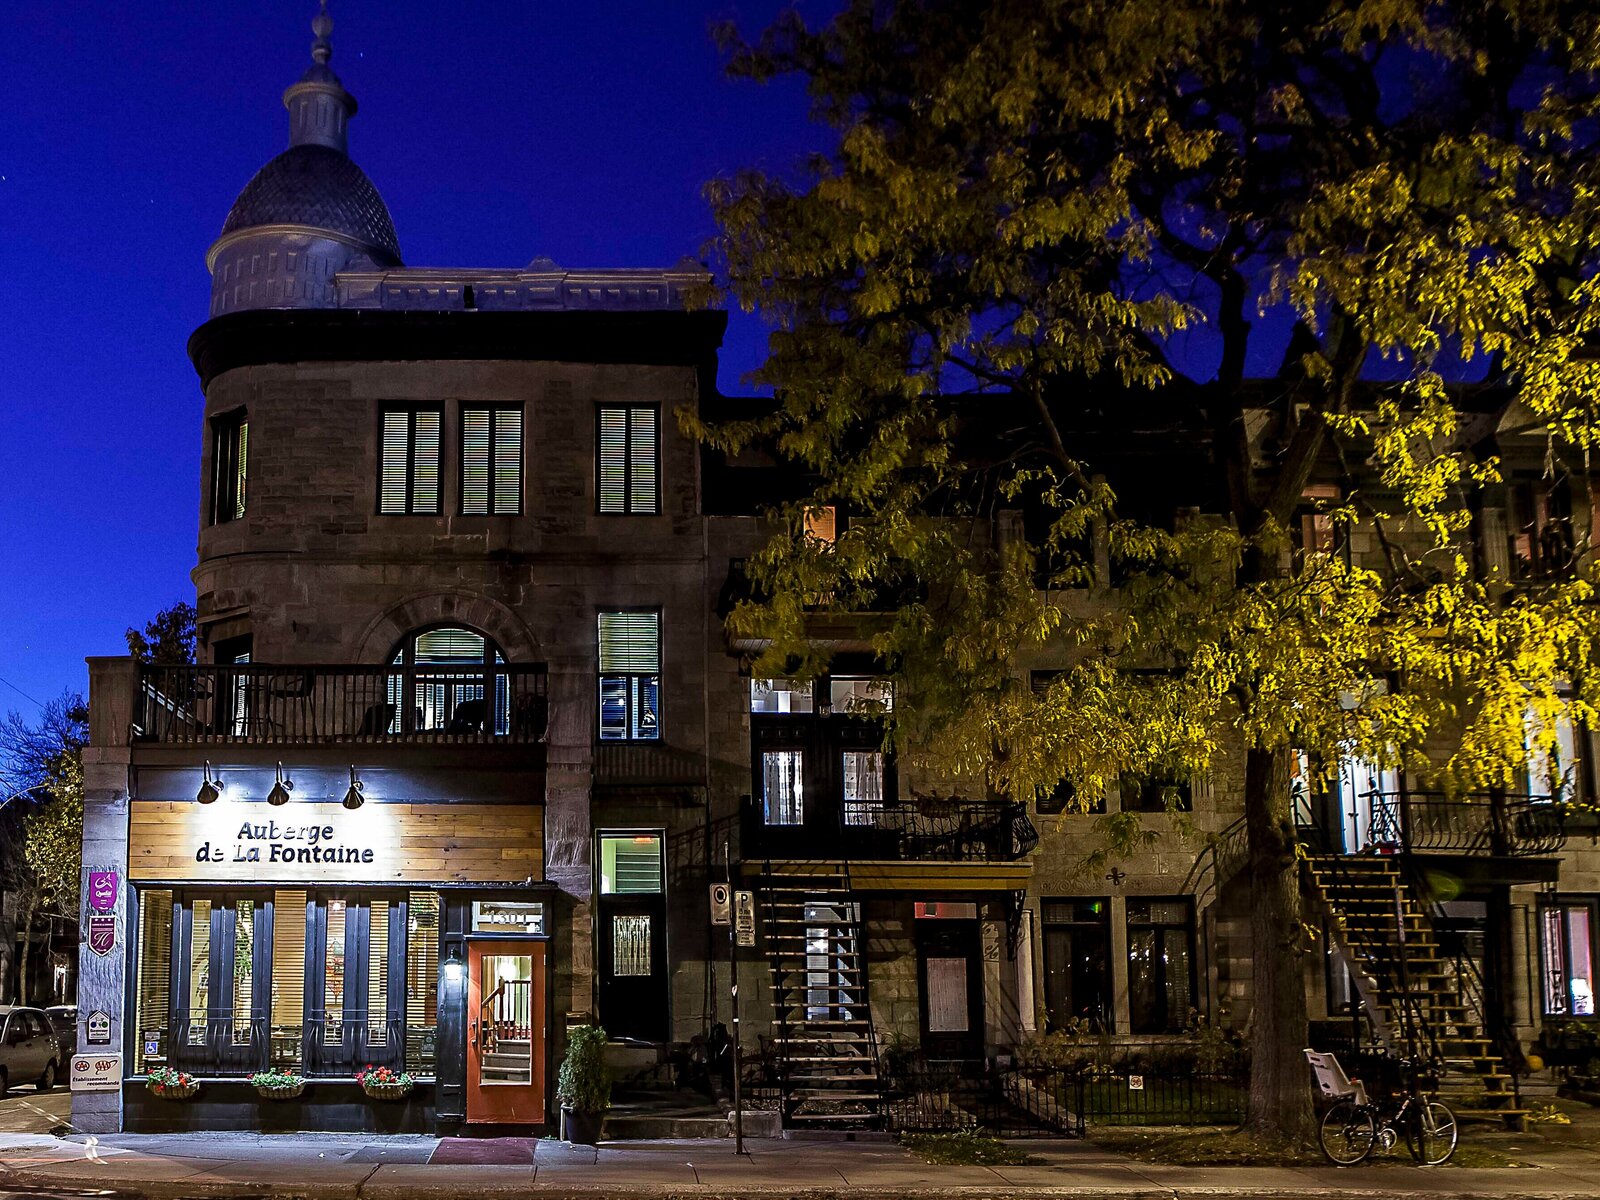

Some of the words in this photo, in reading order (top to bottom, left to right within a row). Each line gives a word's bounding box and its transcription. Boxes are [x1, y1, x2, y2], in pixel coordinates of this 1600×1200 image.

[237, 820, 334, 845] Auberge
[195, 842, 225, 863] de
[232, 844, 261, 863] La
[269, 843, 375, 864] Fontaine
[741, 894, 748, 907] P
[485, 910, 527, 924] 1301
